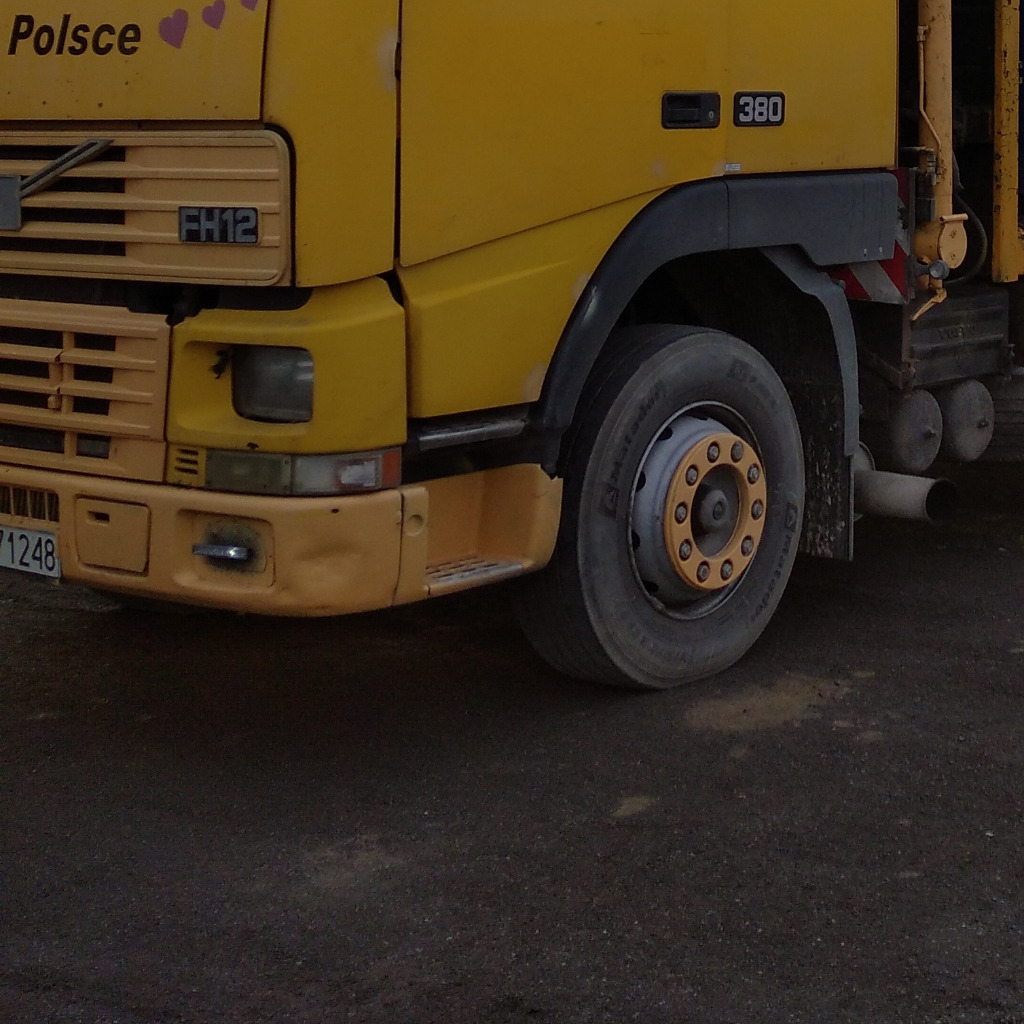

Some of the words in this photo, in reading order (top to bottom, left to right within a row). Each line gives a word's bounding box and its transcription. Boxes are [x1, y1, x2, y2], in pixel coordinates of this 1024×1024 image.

[8, 13, 141, 56] Polsce
[739, 96, 783, 122] 380
[181, 208, 257, 243] FH12
